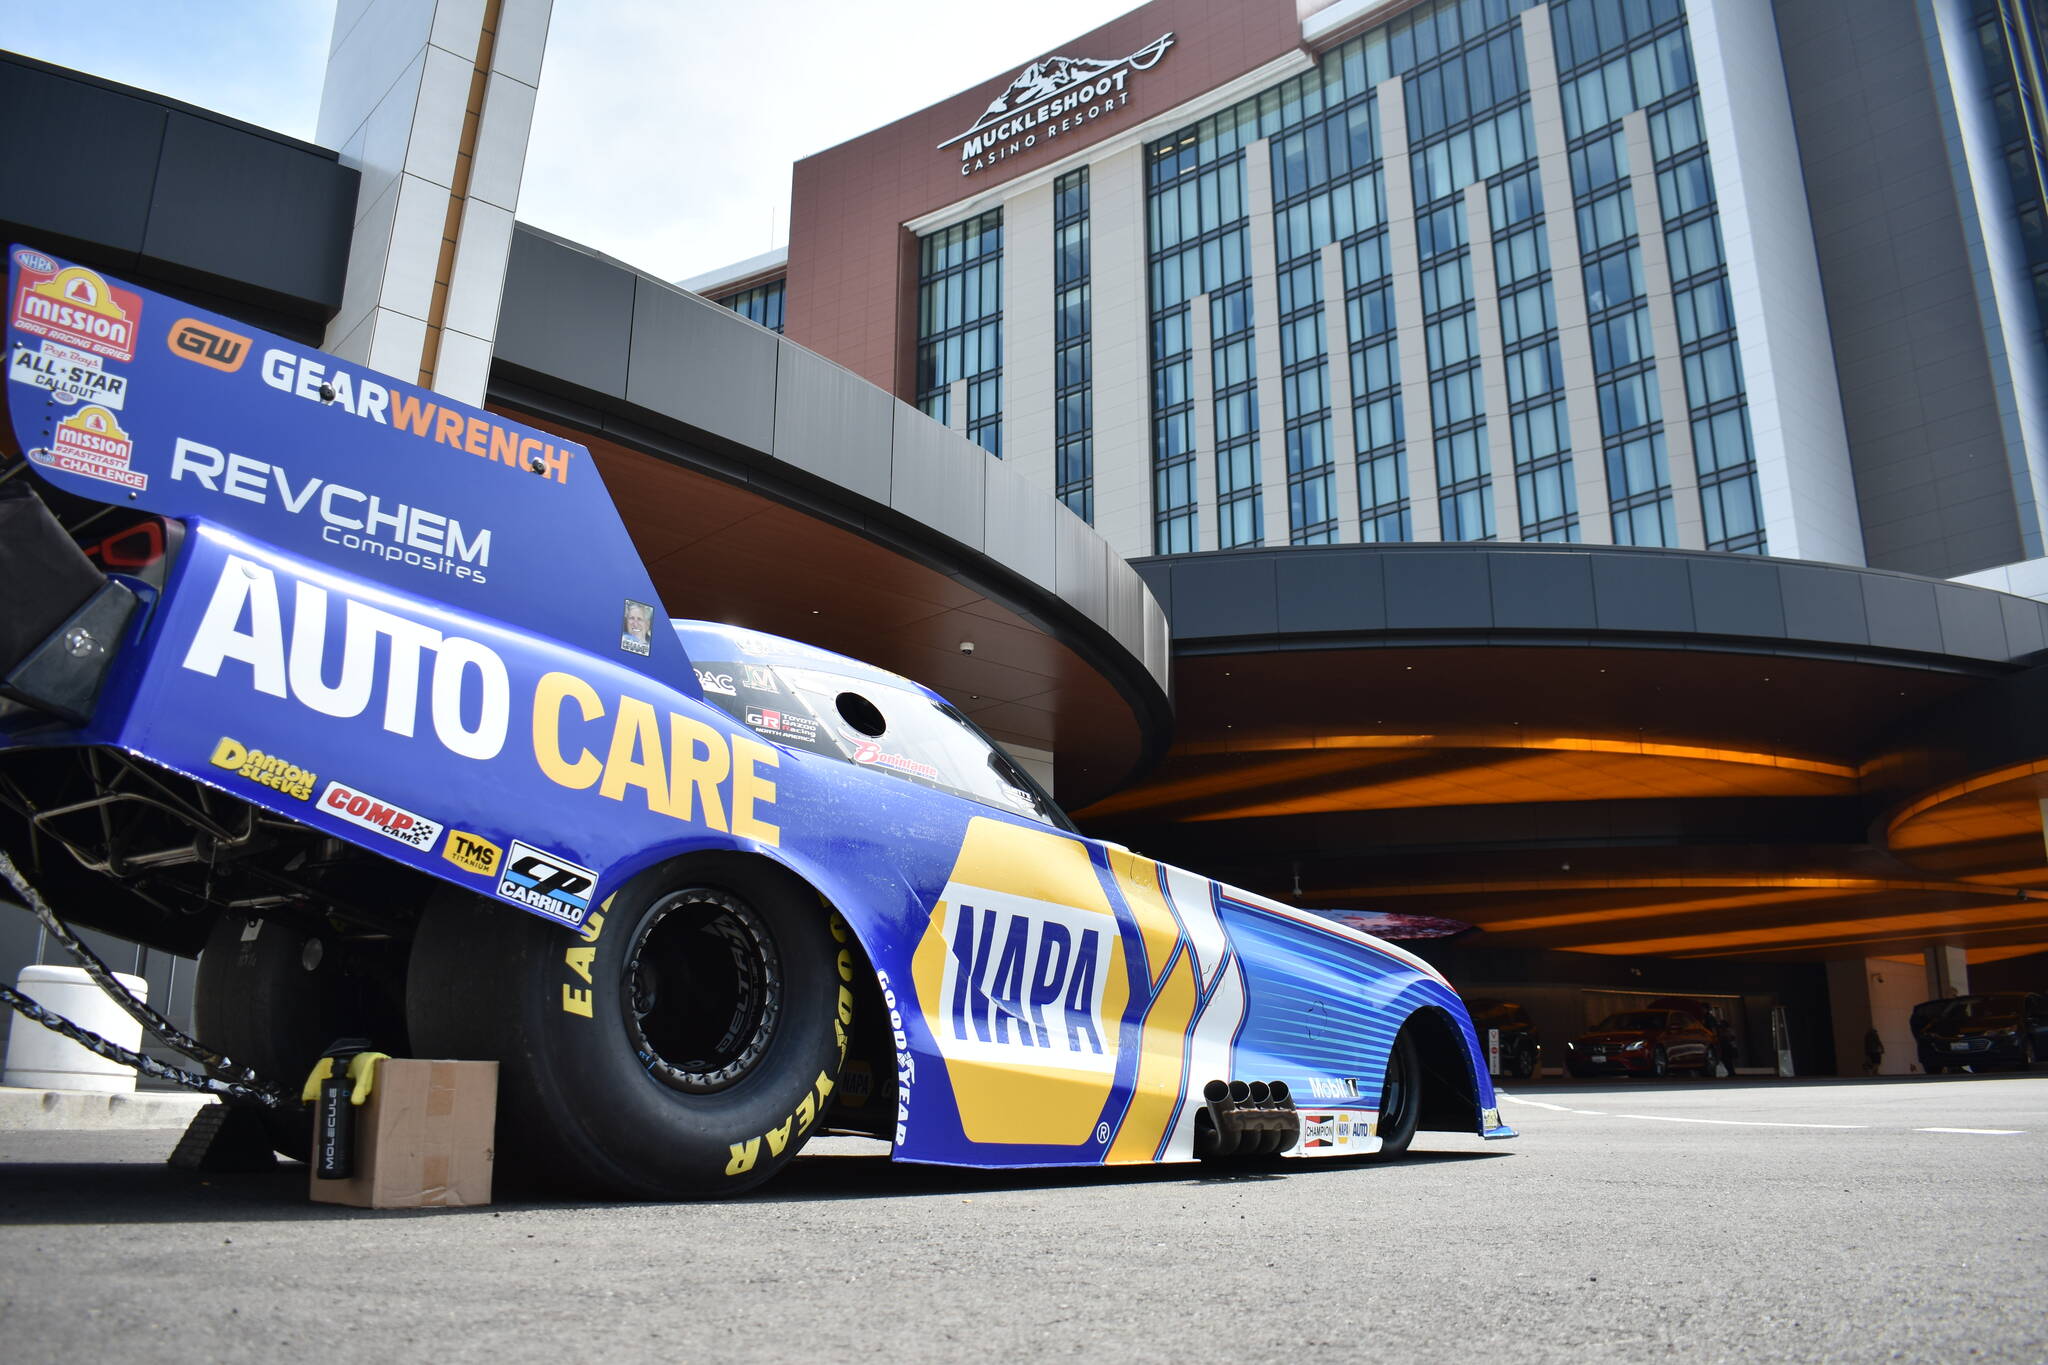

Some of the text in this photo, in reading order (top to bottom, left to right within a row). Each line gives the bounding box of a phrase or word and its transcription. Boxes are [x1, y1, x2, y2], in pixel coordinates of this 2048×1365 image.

[961, 69, 1129, 161] MUCKLESHOOT
[961, 92, 1129, 175] CASINO RESORT
[14, 319, 132, 361] DRAG RACING SERIES
[16, 353, 123, 394] ALL STAR
[35, 374, 97, 399] CALLOUT
[261, 348, 570, 484] GEARWRENCH
[60, 458, 144, 487] CHALLENGE
[170, 437, 491, 567] REVCHEM
[322, 525, 487, 584] Composites
[182, 554, 780, 847] AUTO CARE
[781, 713, 819, 727] TOYOTA
[746, 713, 780, 730] GR
[755, 727, 816, 743] NORTH AMERICA
[781, 719, 817, 732] GAZOO
[781, 725, 817, 738] Racing
[210, 736, 318, 789] DARTON
[237, 762, 313, 801] SLEEVES
[327, 788, 414, 832] COMP
[381, 825, 422, 845] CAMS
[455, 836, 494, 866] TMS
[452, 852, 490, 873] TITANIUM
[500, 881, 584, 923] CARRILLO
[563, 891, 617, 1018] EAG
[951, 903, 1104, 1056] NAPA
[877, 968, 915, 1146] GOODYEAR
[1309, 1077, 1359, 1098] Mobil 1
[325, 1087, 337, 1170] MOLECULE
[1306, 1125, 1333, 1137] CHAMPION
[1352, 1122, 1368, 1136] AUTO
